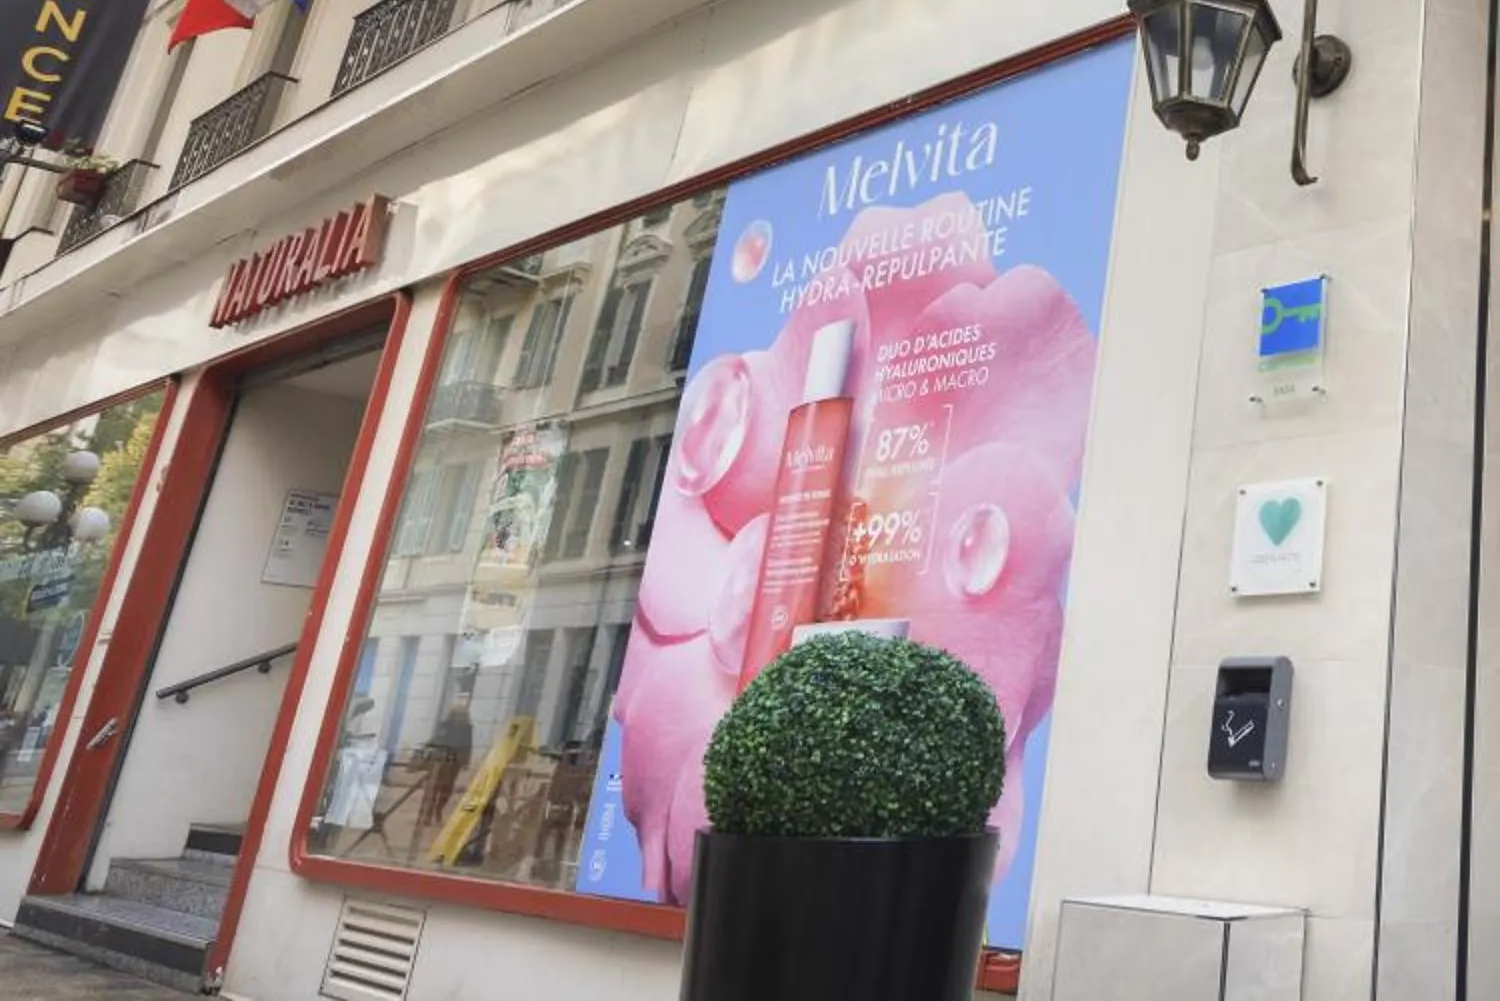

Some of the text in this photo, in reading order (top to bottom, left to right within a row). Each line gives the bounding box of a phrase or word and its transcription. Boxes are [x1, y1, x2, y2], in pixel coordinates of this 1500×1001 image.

[818, 120, 998, 218] Melvita
[209, 193, 387, 329] NATURALIA
[771, 186, 1032, 288] LA NOUVELLE ROUTINE
[779, 227, 1008, 313] HYDRA-REPULPANTE
[876, 323, 982, 363] DUO D'ACIDES
[876, 342, 998, 382] HYALURONIQUES
[934, 366, 989, 392] MACRO
